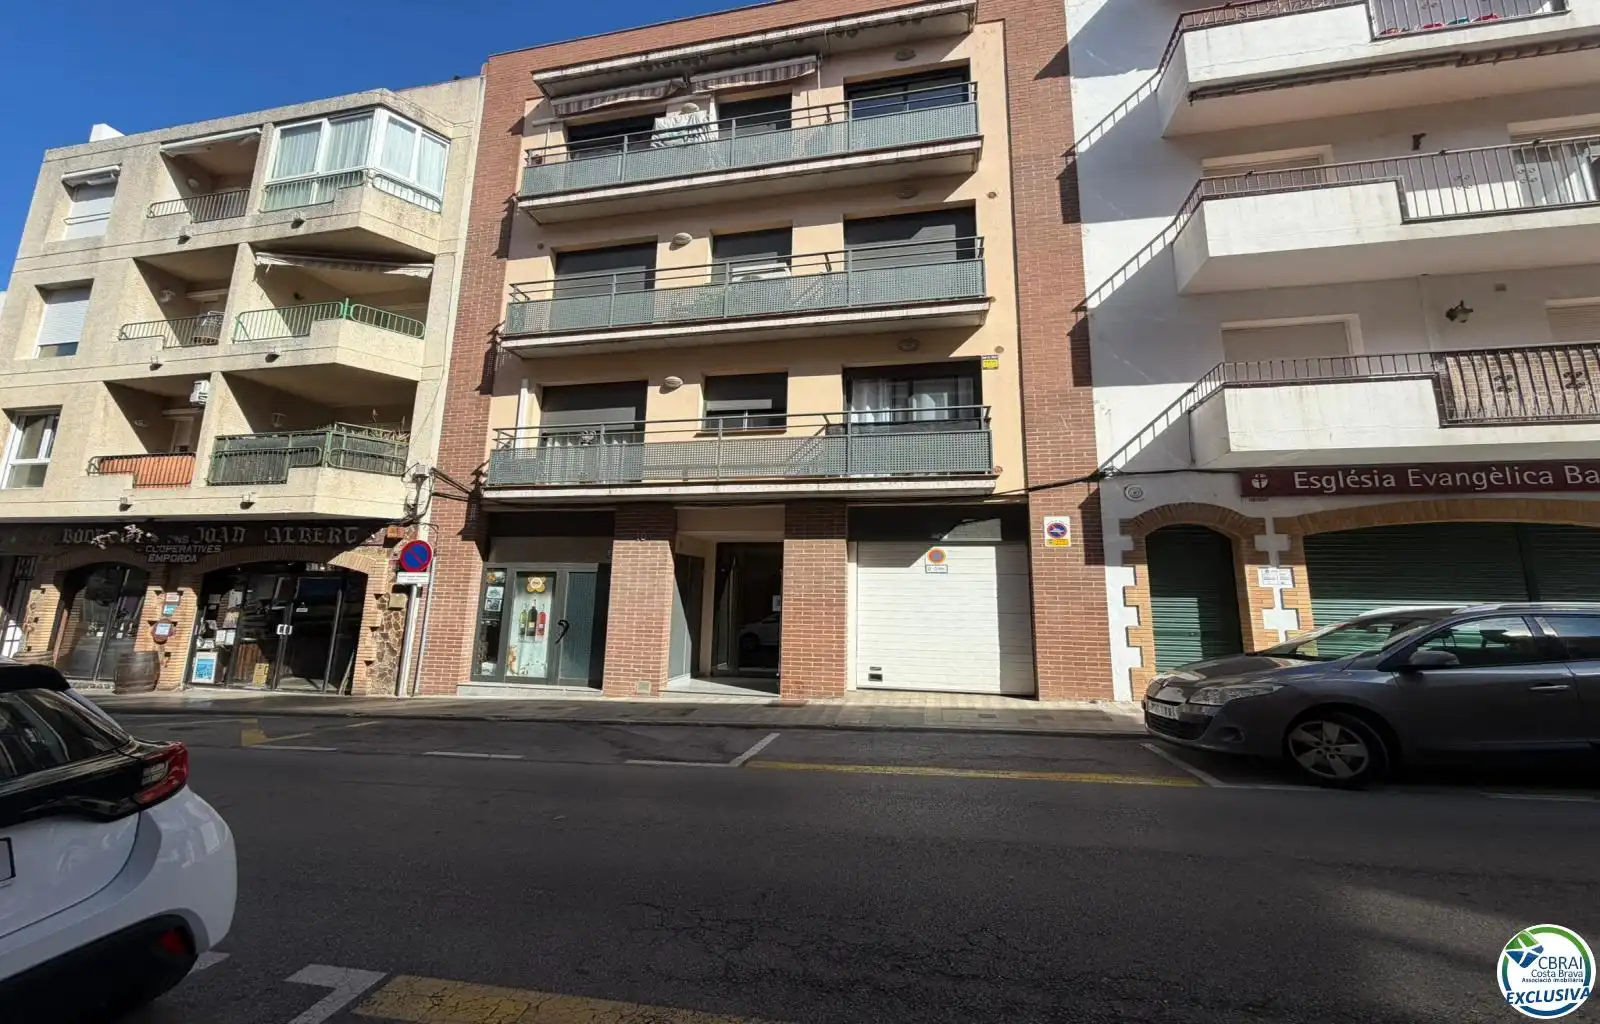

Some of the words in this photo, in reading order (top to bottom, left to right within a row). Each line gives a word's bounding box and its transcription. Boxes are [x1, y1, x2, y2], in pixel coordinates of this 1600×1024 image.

[1293, 469, 1396, 493] Església
[1407, 466, 1554, 490] Evangèlica
[1564, 465, 1600, 484] Ba
